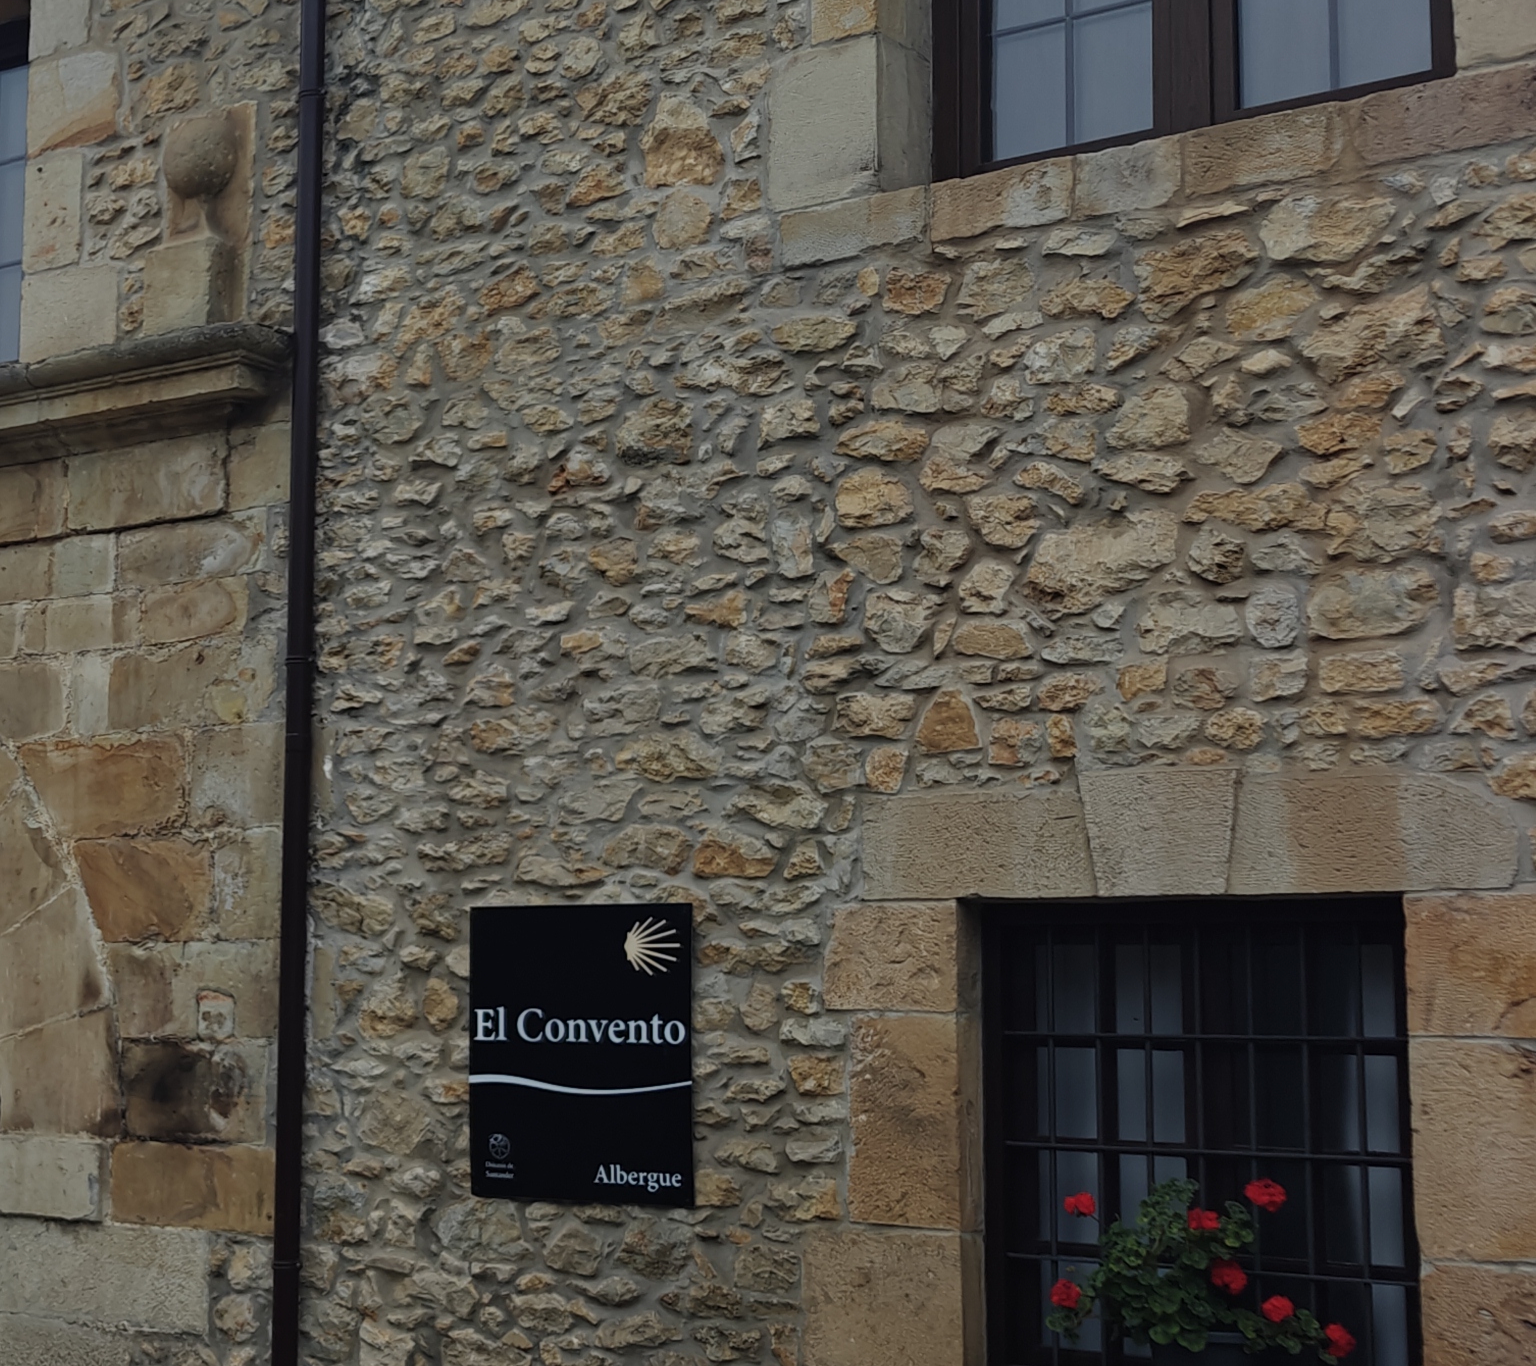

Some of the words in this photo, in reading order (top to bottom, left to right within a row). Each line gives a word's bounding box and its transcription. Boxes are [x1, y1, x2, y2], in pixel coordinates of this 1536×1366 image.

[473, 1006, 507, 1042] El
[516, 1008, 686, 1045] Convento
[594, 1164, 682, 1192] Albergue
